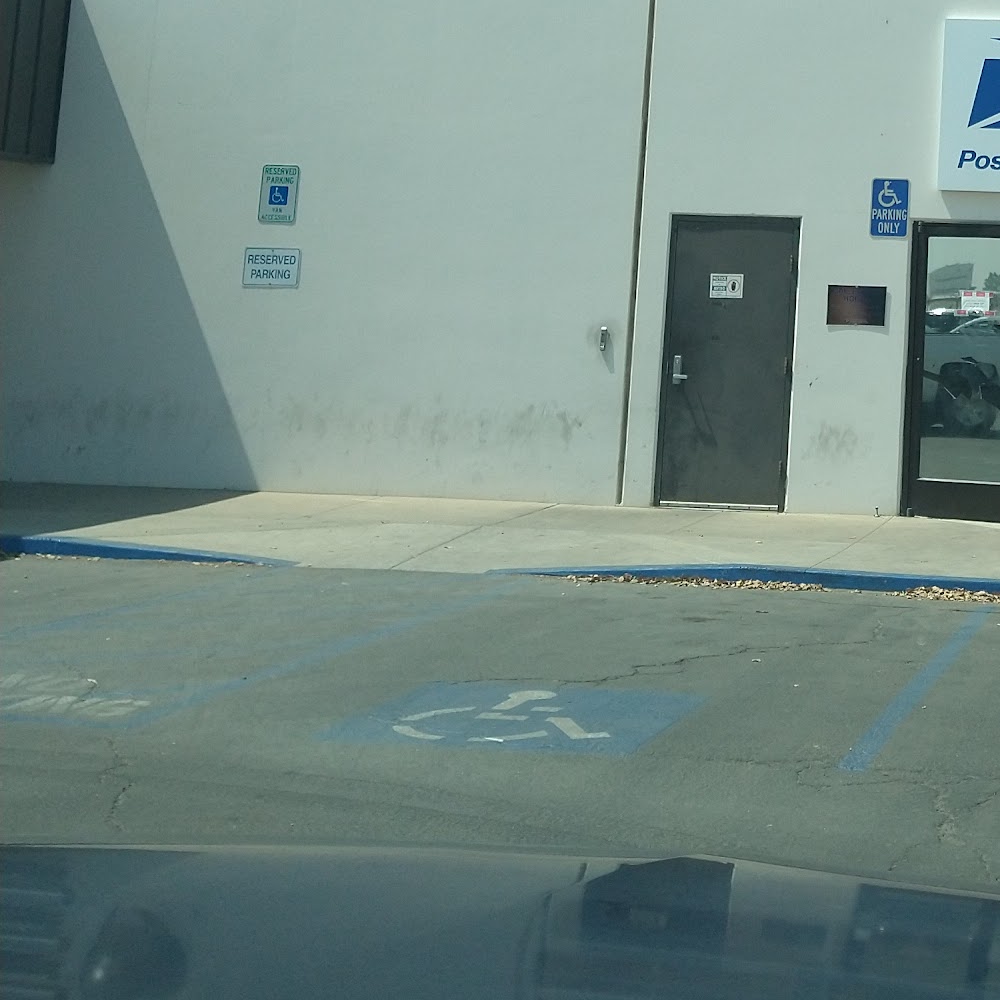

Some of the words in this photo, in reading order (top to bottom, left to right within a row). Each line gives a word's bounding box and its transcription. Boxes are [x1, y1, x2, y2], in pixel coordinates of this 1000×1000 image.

[264, 167, 297, 176] RESERVED
[265, 176, 295, 185] PARKING
[871, 208, 908, 221] PARKING
[877, 221, 900, 234] ONLY
[247, 254, 297, 265] RESERVED
[250, 268, 291, 280] PARKING
